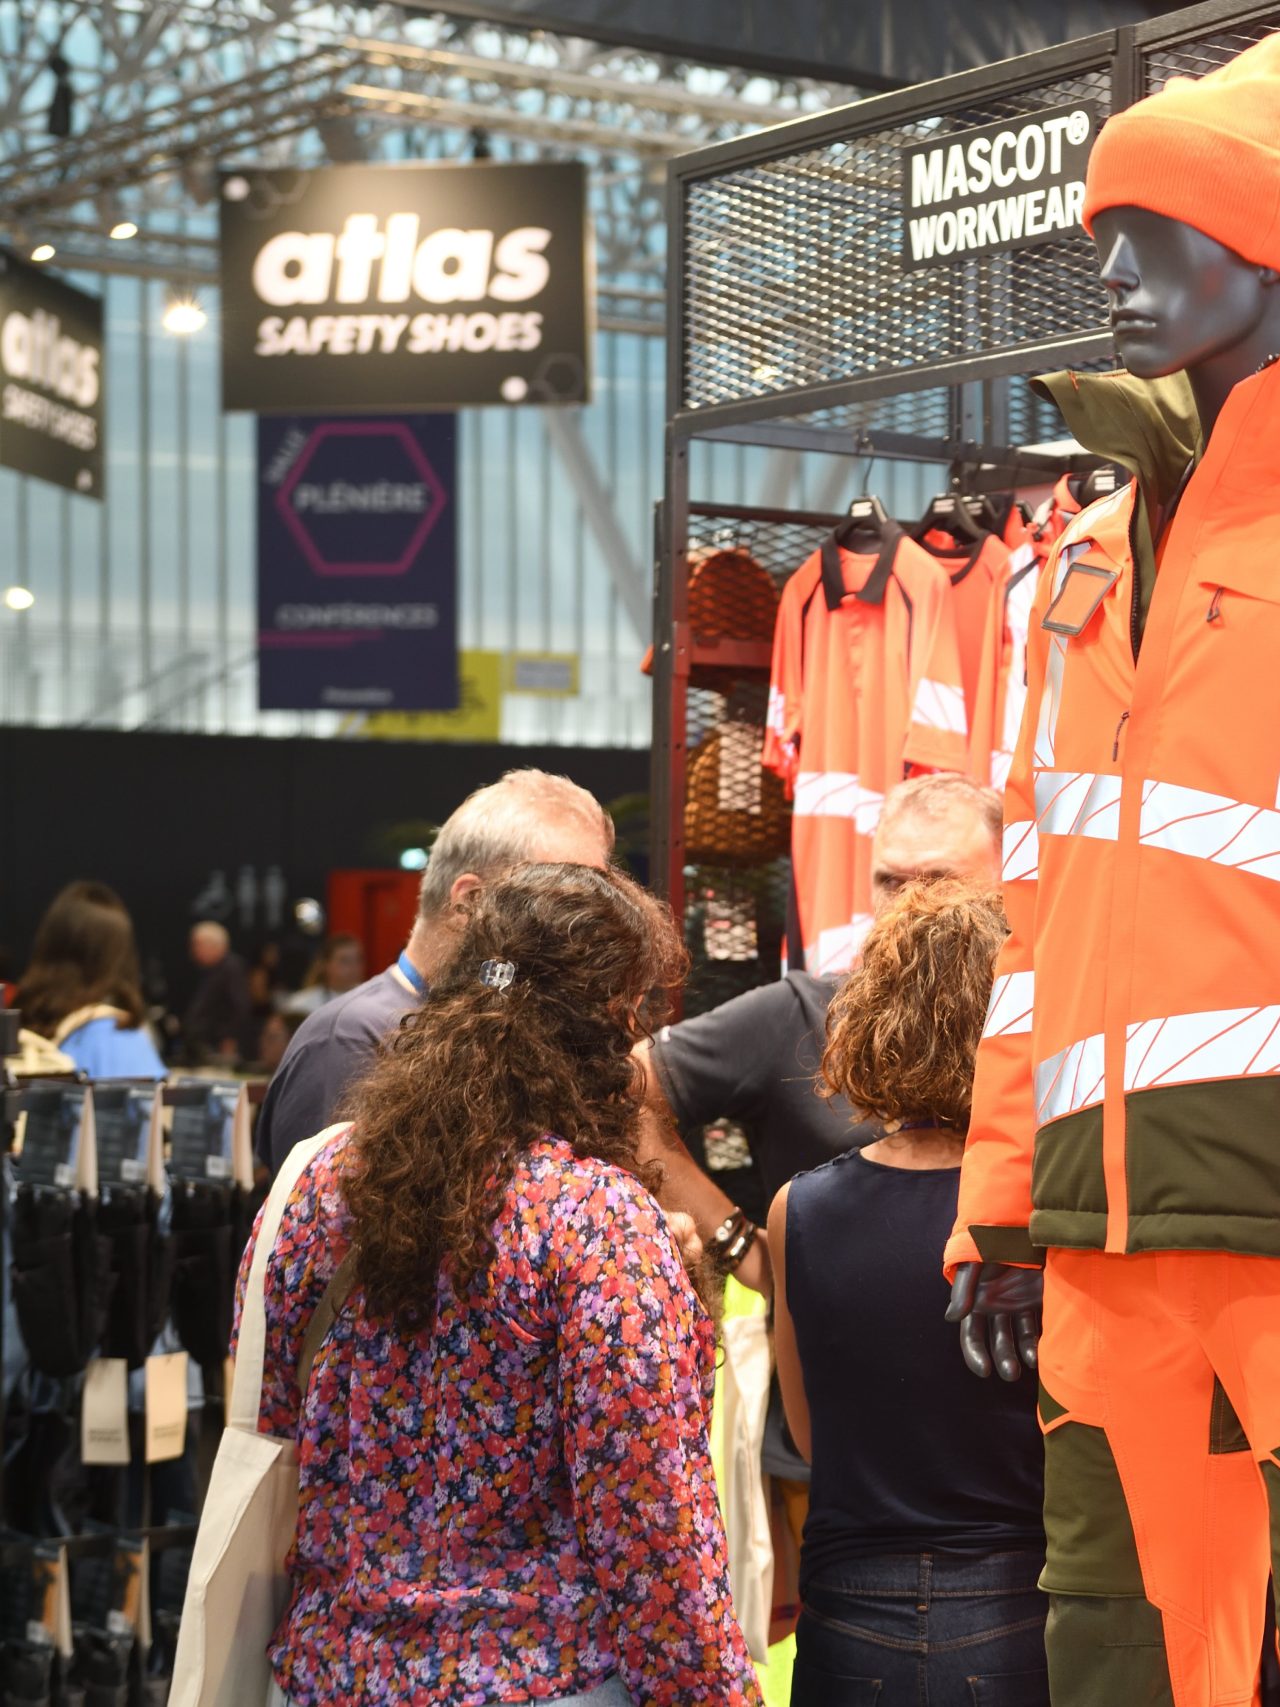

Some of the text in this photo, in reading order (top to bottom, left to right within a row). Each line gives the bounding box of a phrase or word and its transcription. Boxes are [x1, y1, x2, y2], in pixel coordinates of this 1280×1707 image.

[253, 212, 553, 306] atlas
[909, 180, 1087, 262] WORKWEAR
[2, 307, 99, 408] atlas
[255, 311, 544, 356] SAFETY SHOES
